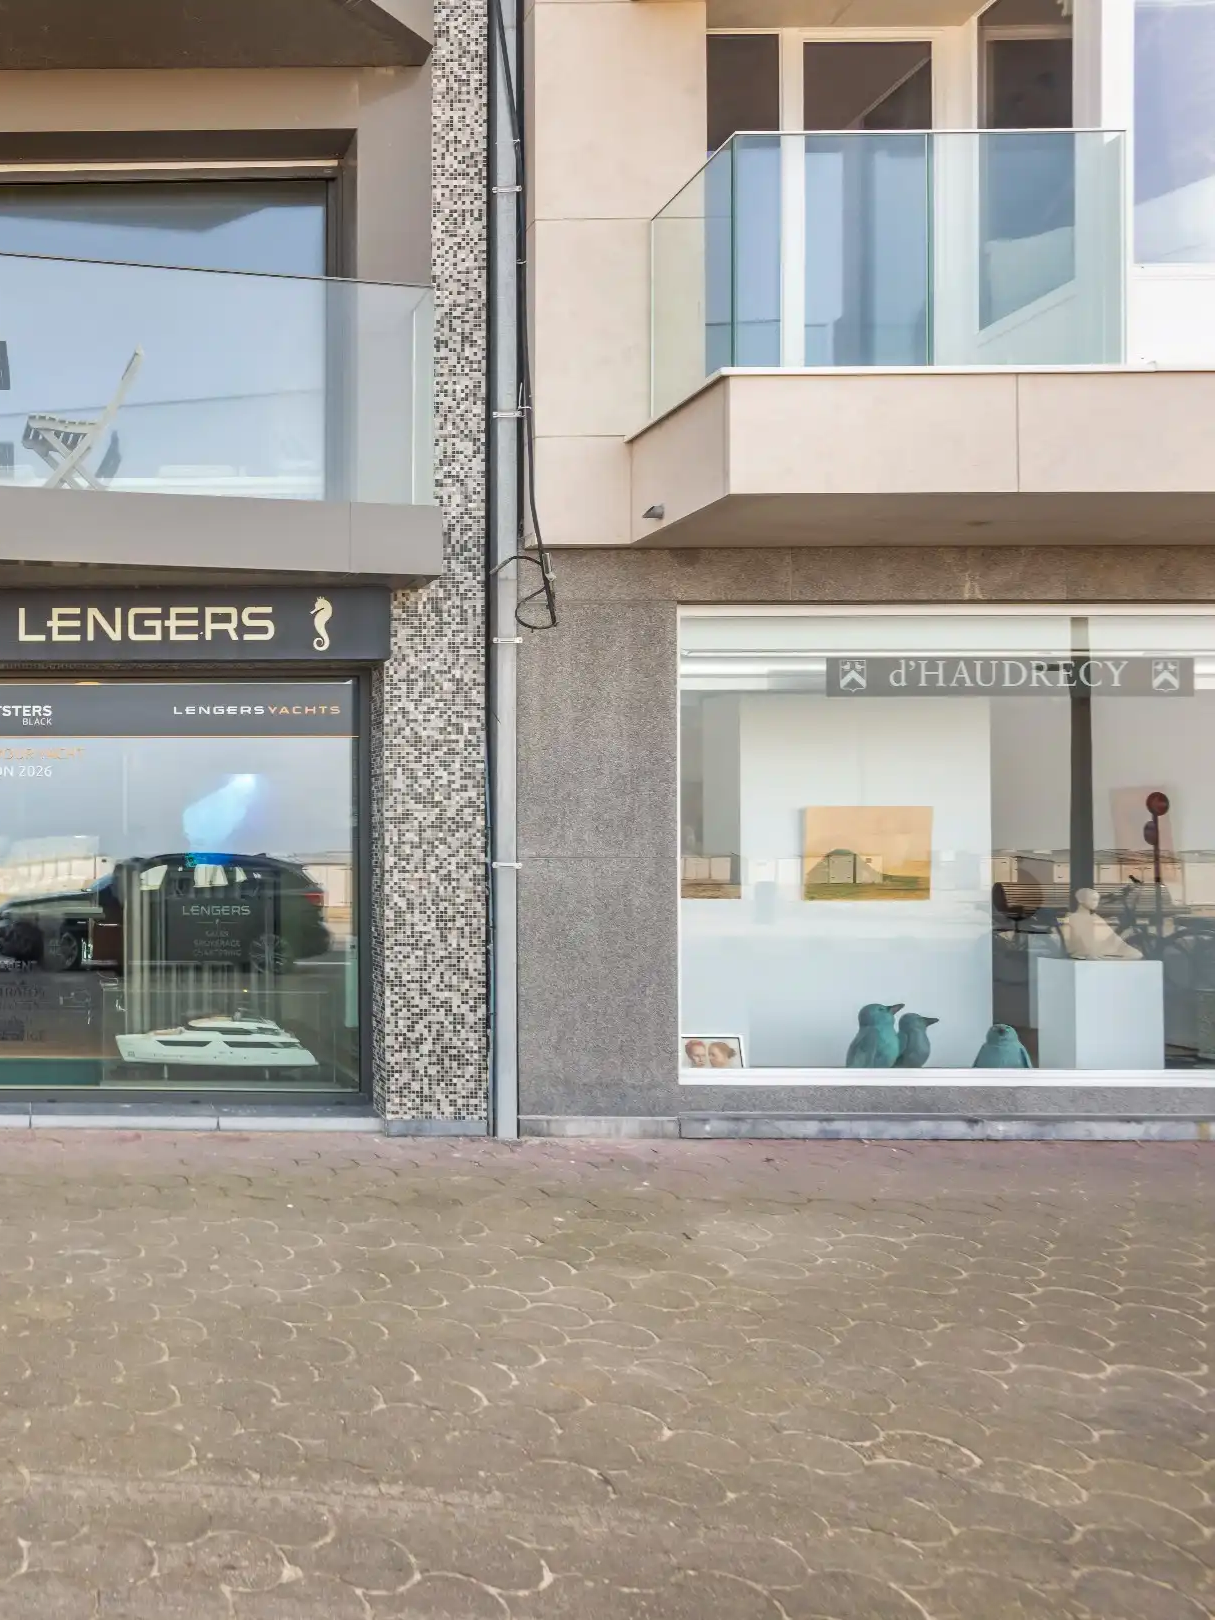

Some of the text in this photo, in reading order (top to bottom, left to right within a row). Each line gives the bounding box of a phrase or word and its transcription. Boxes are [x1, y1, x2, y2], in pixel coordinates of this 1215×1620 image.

[18, 606, 276, 642] LENGERS
[22, 718, 53, 726] BLACK
[19, 765, 53, 777] 2026
[182, 905, 251, 916] LENGERS
